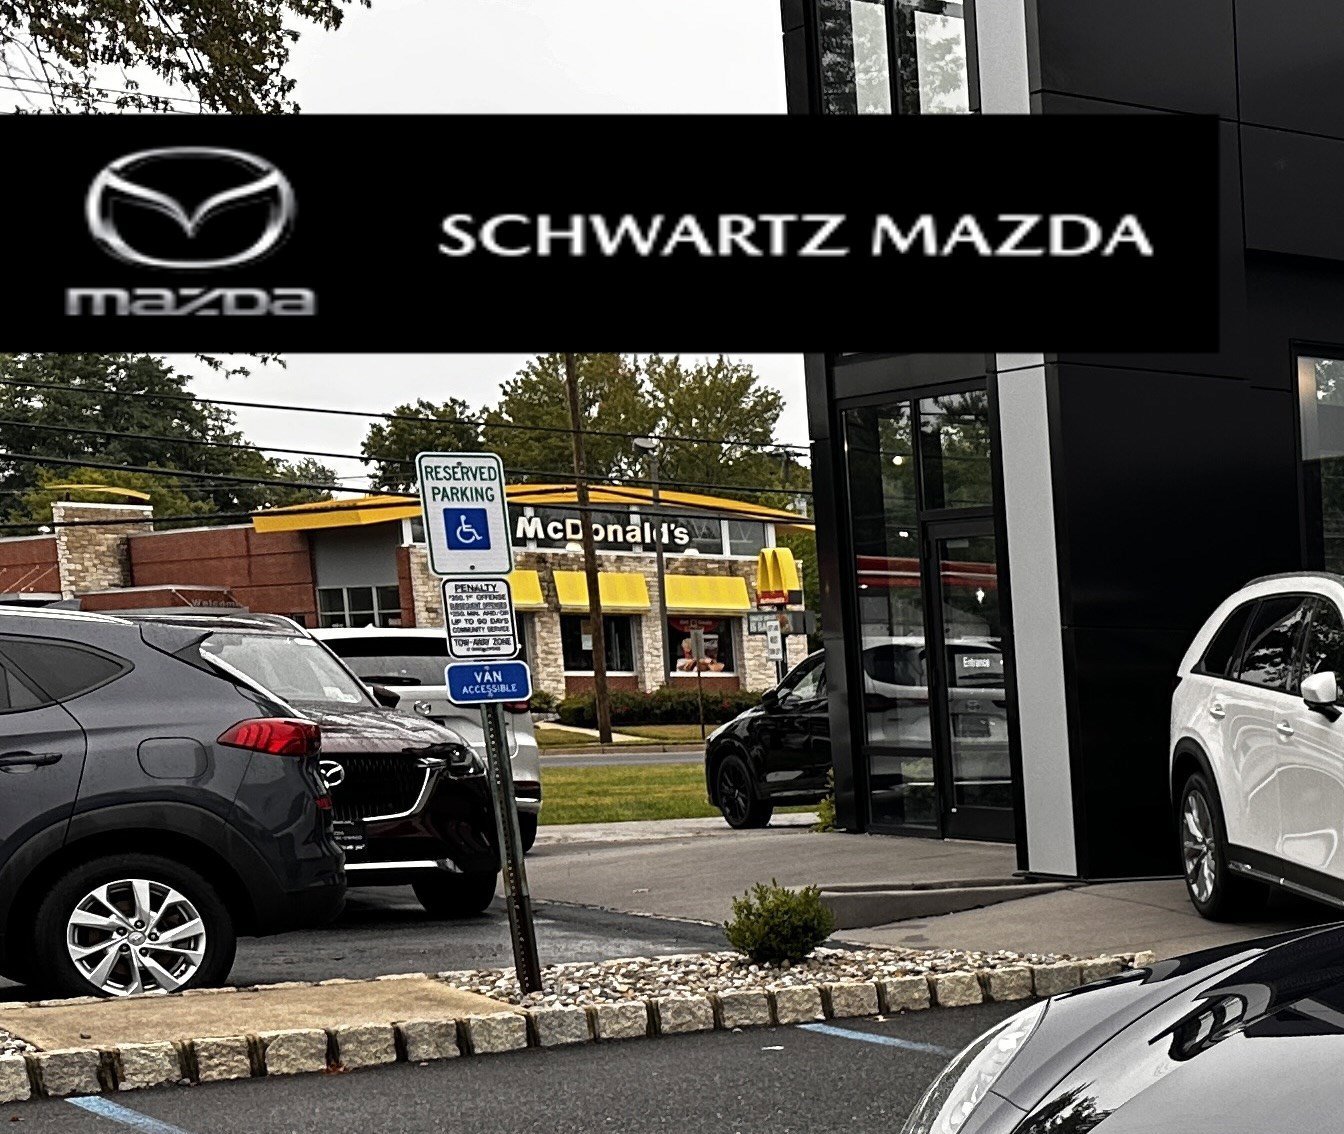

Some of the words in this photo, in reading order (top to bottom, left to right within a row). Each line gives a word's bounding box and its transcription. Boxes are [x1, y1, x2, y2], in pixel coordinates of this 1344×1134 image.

[424, 465, 497, 481] RESERVED
[431, 486, 495, 502] PARKING
[516, 516, 690, 545] McDonald's
[454, 584, 498, 592] PENALTY
[474, 671, 503, 683] VAN
[462, 684, 518, 694] ACCESSIBLE
